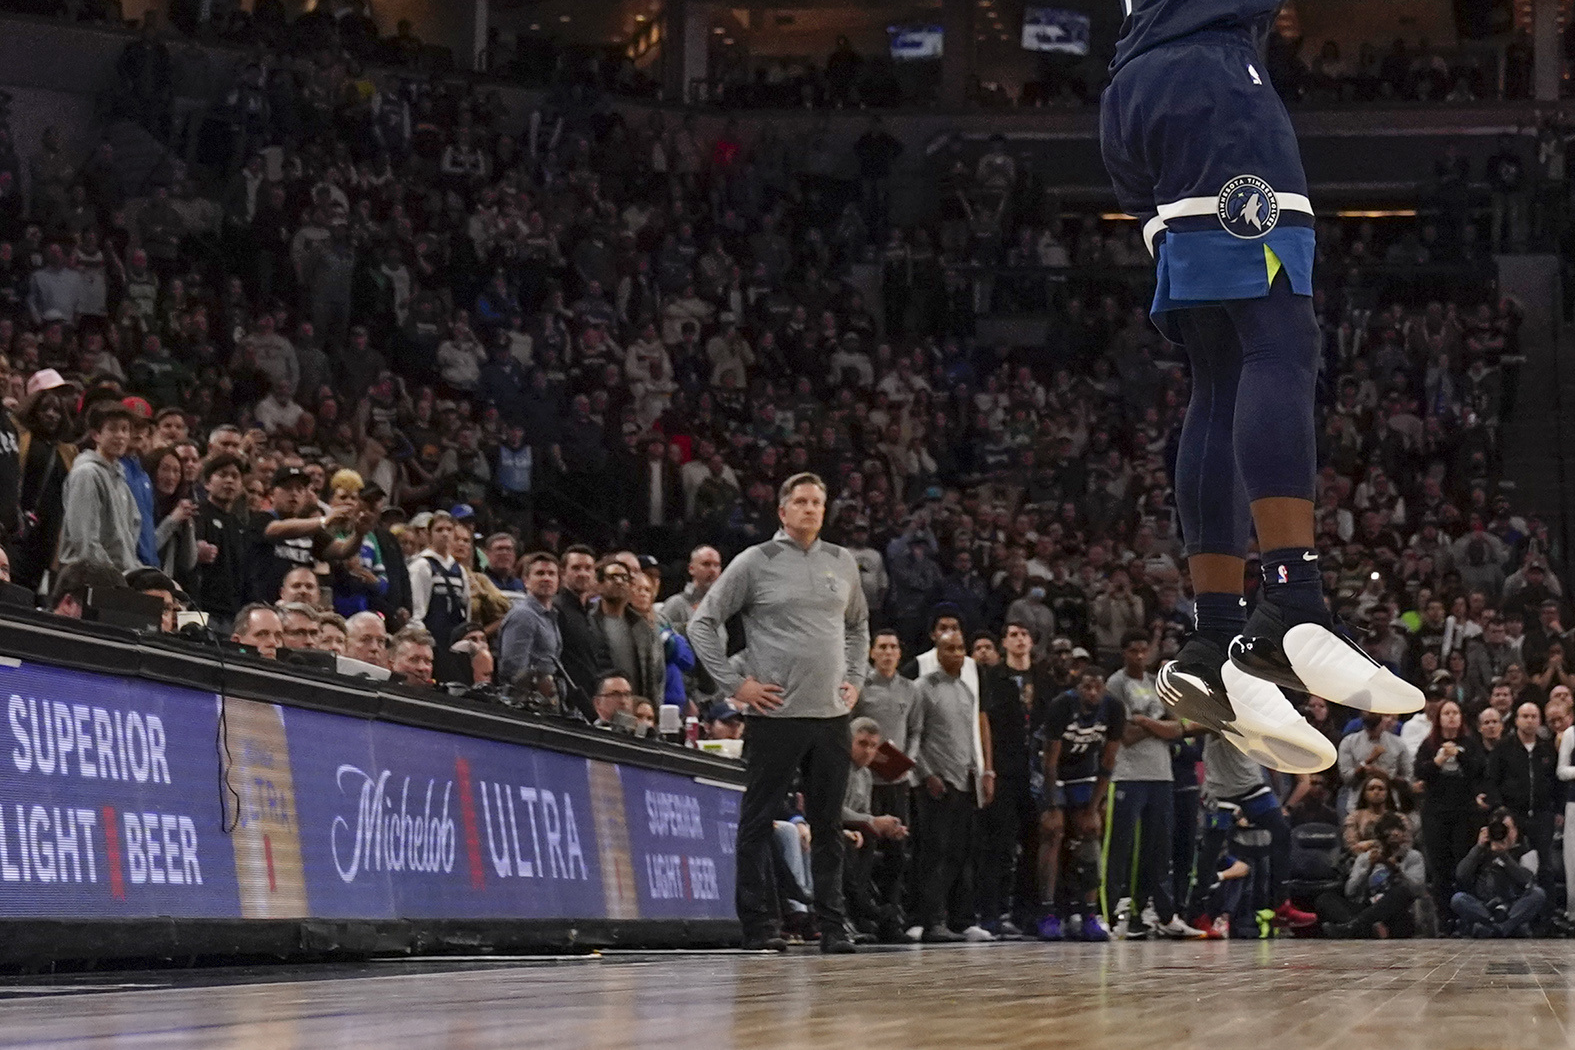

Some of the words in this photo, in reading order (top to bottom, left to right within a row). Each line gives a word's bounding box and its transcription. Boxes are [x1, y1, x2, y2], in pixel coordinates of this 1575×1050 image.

[1219, 179, 1245, 219] MINNESOTA
[1246, 177, 1277, 227] TIMBERWOLVES
[8, 694, 172, 785] SUPERIOR
[0, 804, 98, 883] LIGHT
[123, 812, 204, 885] BEER
[331, 763, 456, 883] Michelob
[480, 780, 588, 880] ULTRA
[645, 852, 684, 900] LIGHT
[687, 855, 721, 900] BEER
